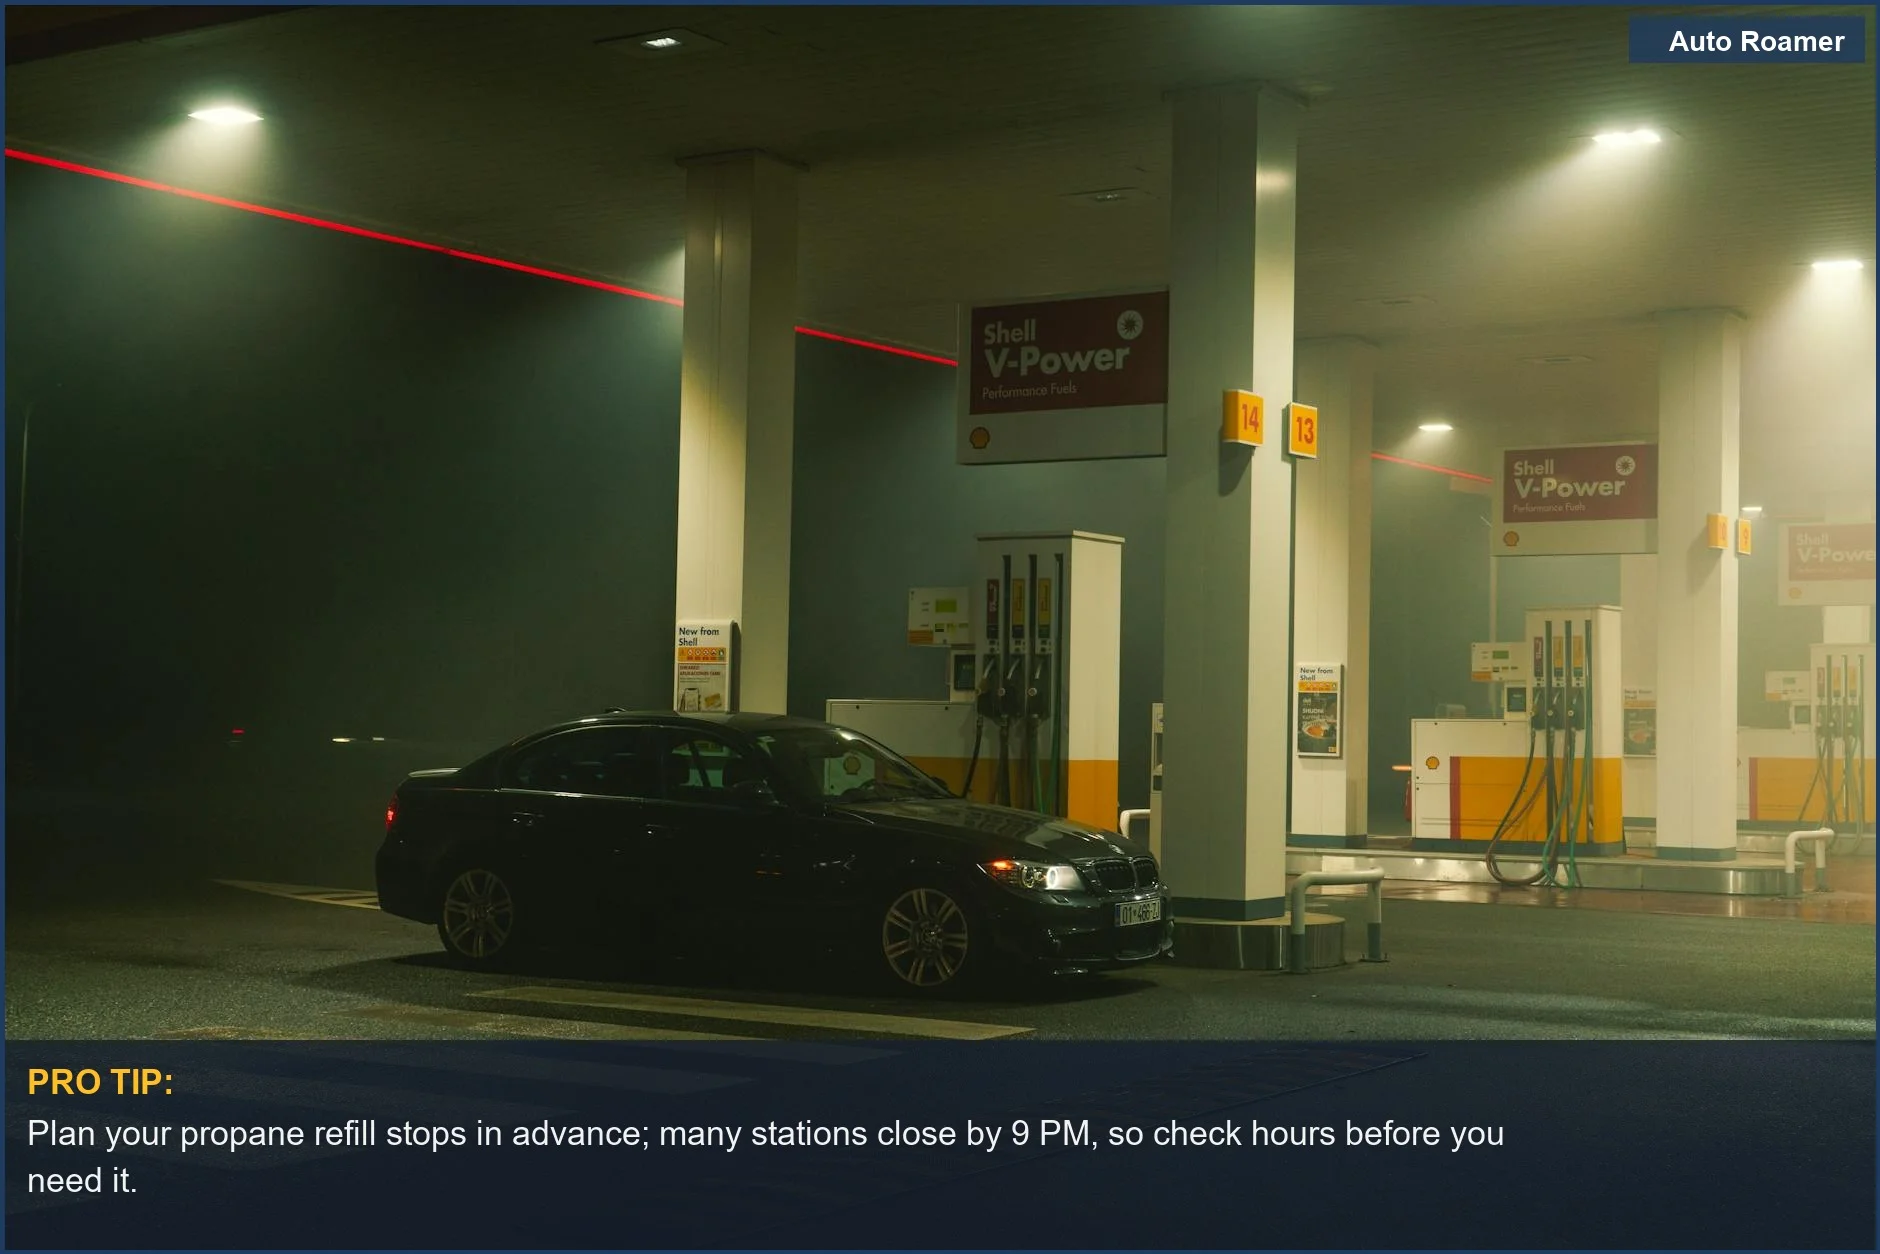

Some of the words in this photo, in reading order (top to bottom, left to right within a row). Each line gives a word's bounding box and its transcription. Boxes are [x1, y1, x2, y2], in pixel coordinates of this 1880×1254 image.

[984, 319, 1036, 345] Shell
[984, 346, 1131, 379] V-Power
[982, 384, 1048, 400] Performance
[1050, 380, 1078, 395] Fuels
[1242, 403, 1260, 433] 14
[1296, 416, 1314, 444] 13
[1513, 459, 1555, 476] Shell
[1513, 477, 1626, 499] V-Power
[1512, 503, 1564, 513] Performance
[1565, 501, 1587, 512] Fuels
[1796, 532, 1829, 546] Shell
[1796, 547, 1876, 563] V-Powe
[678, 627, 698, 636] New
[700, 626, 720, 636] from
[678, 637, 698, 646] Shell
[1317, 666, 1333, 674] from
